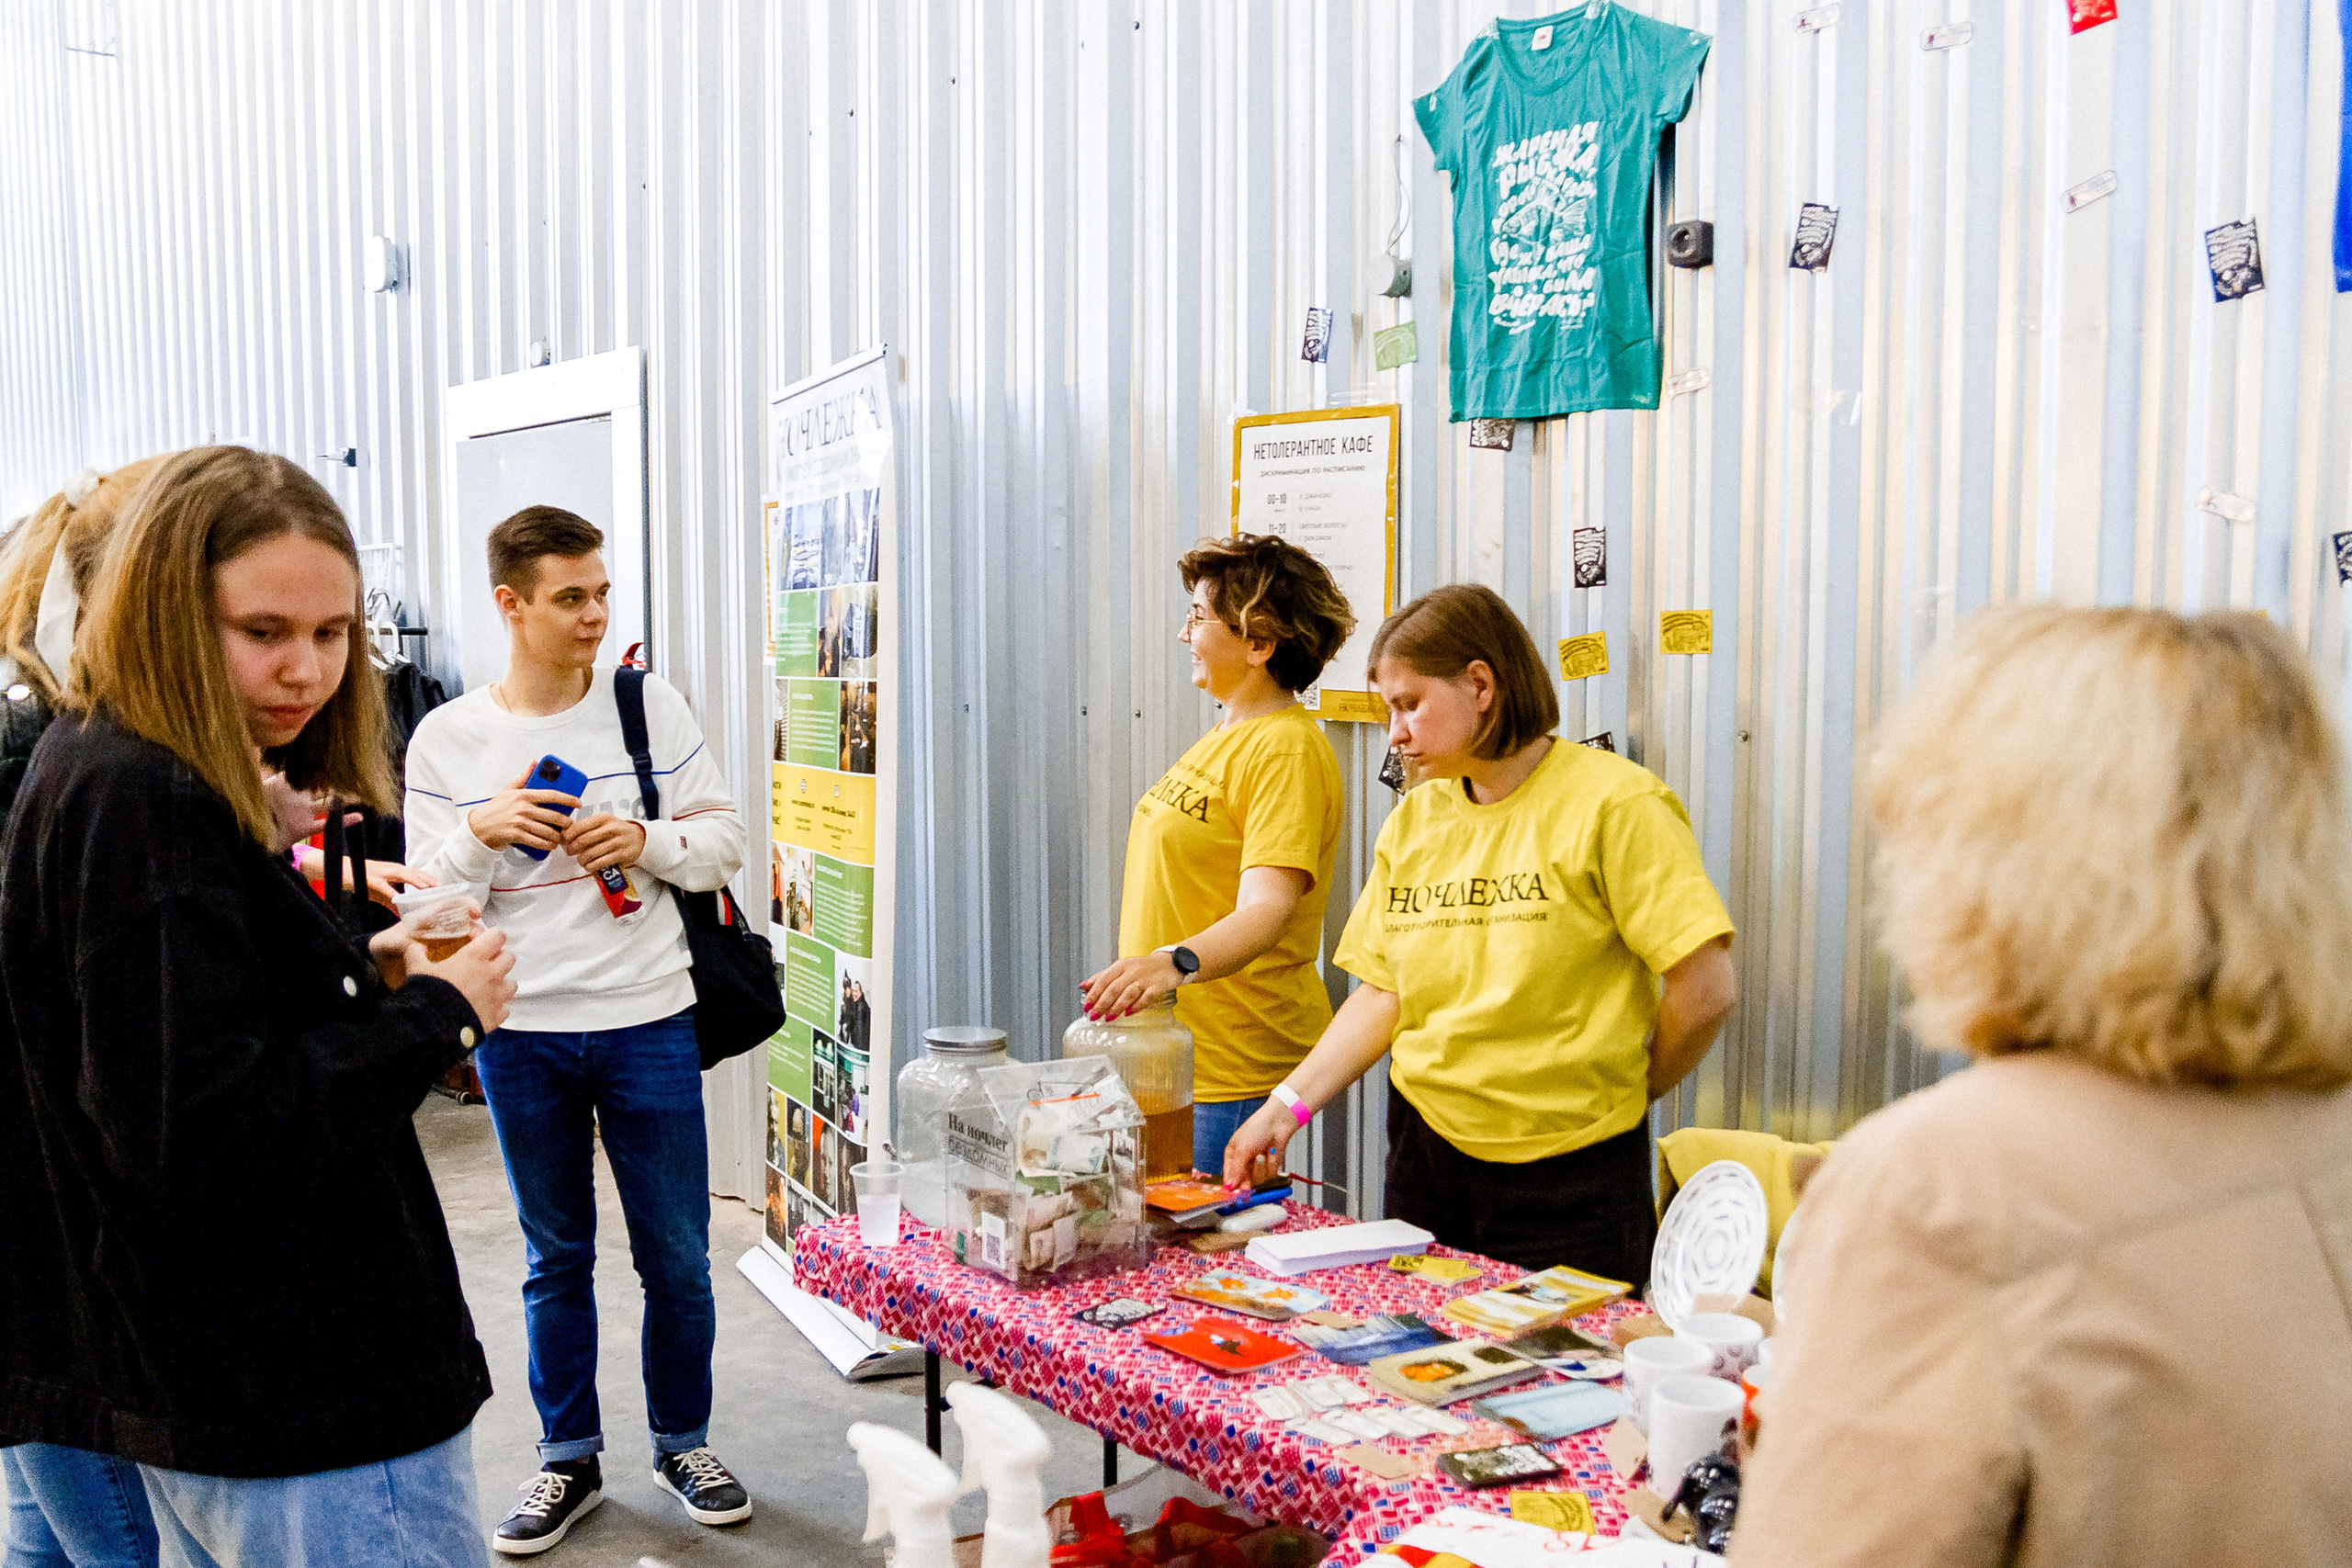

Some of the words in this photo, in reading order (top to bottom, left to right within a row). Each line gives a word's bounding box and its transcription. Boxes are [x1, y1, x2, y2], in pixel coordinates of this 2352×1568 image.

[1253, 437, 1337, 460] НЕТОЛЕРАНТНОЕ
[1341, 435, 1374, 454] КАФЕ
[948, 1112, 965, 1134] На
[967, 1124, 1009, 1152] ночлег
